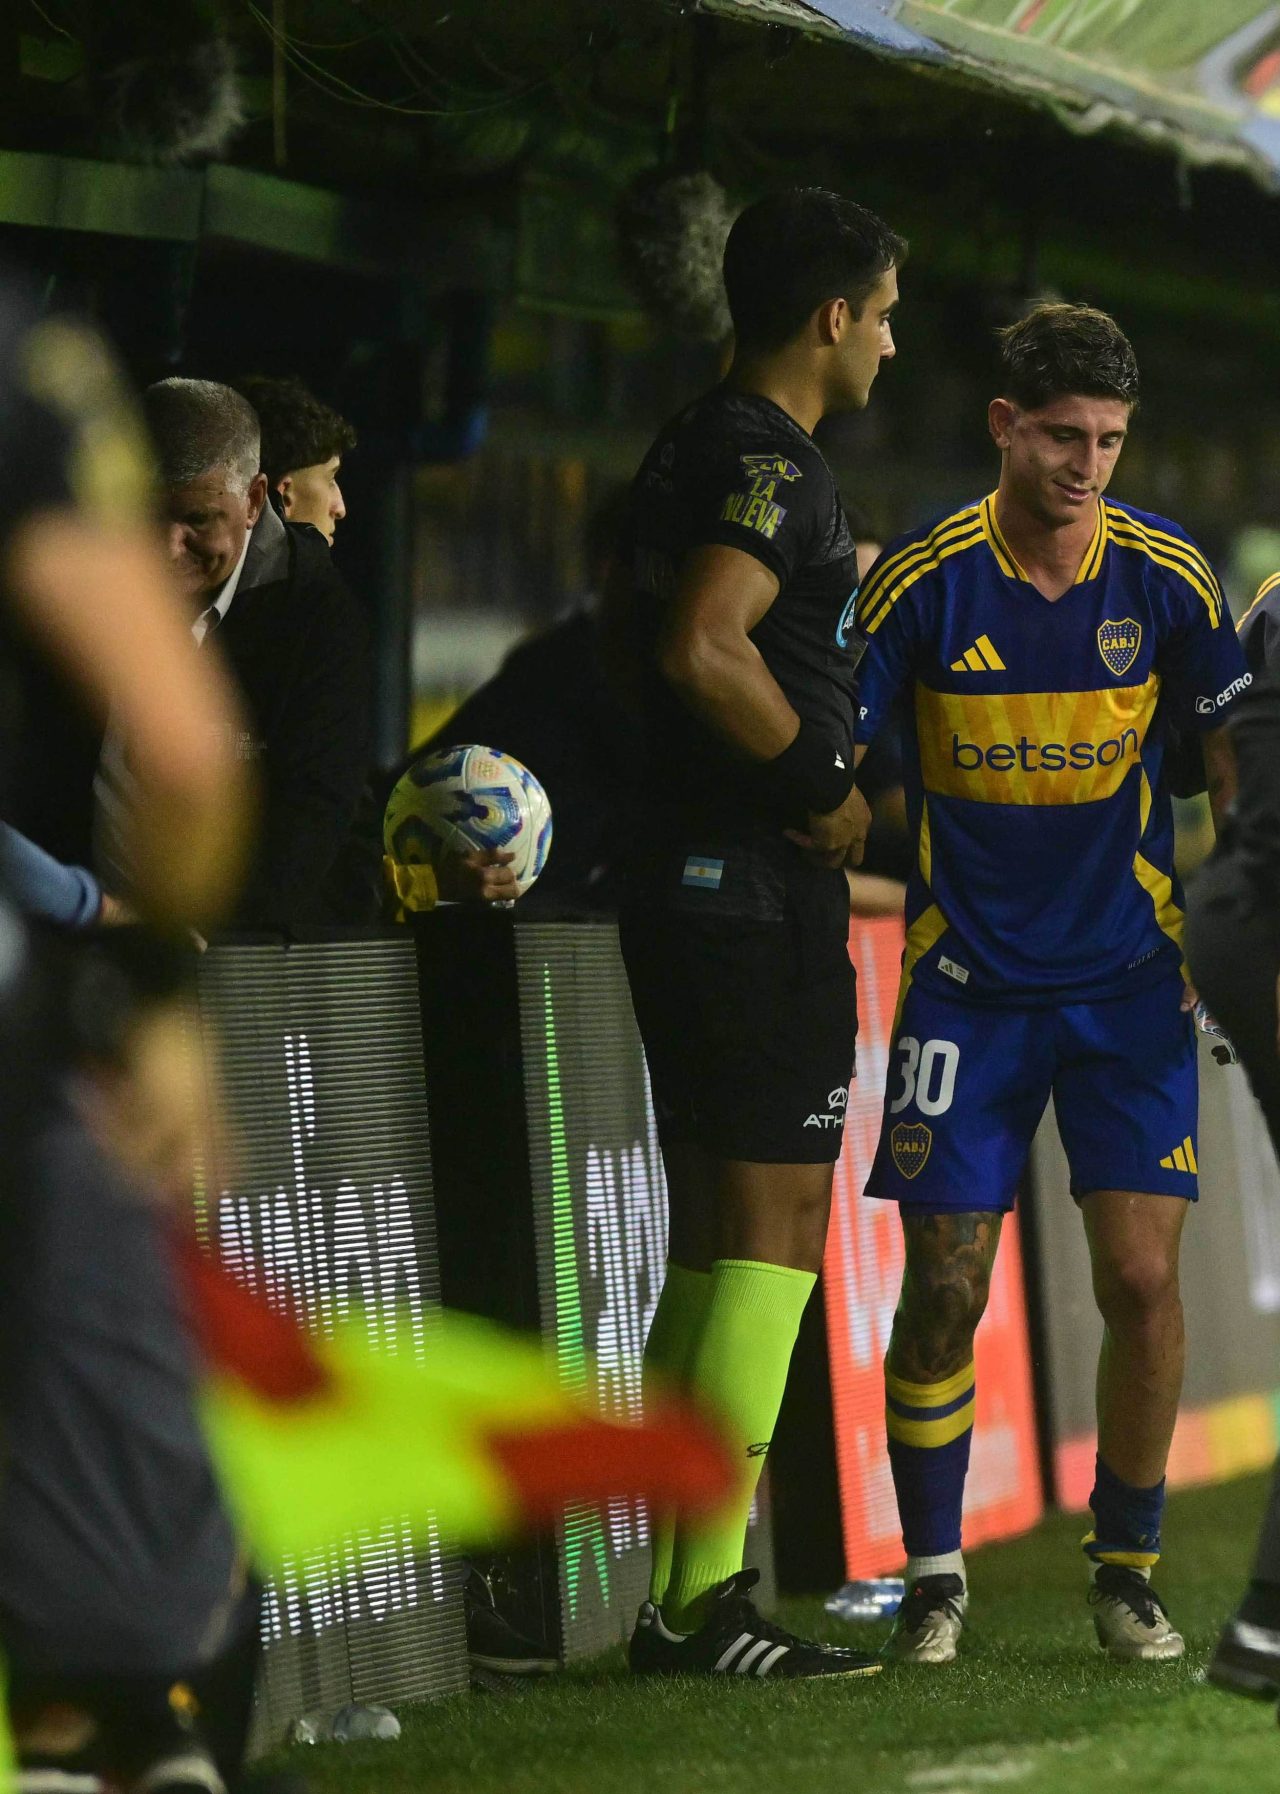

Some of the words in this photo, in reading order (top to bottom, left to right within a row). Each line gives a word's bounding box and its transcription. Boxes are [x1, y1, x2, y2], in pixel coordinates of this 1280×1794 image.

[750, 476, 777, 501] LA
[721, 494, 778, 539] NUEVA
[1102, 637, 1136, 651] CABJ
[953, 728, 1138, 772] betsson
[889, 1036, 960, 1116] 30
[895, 1141, 926, 1153] CABJ
